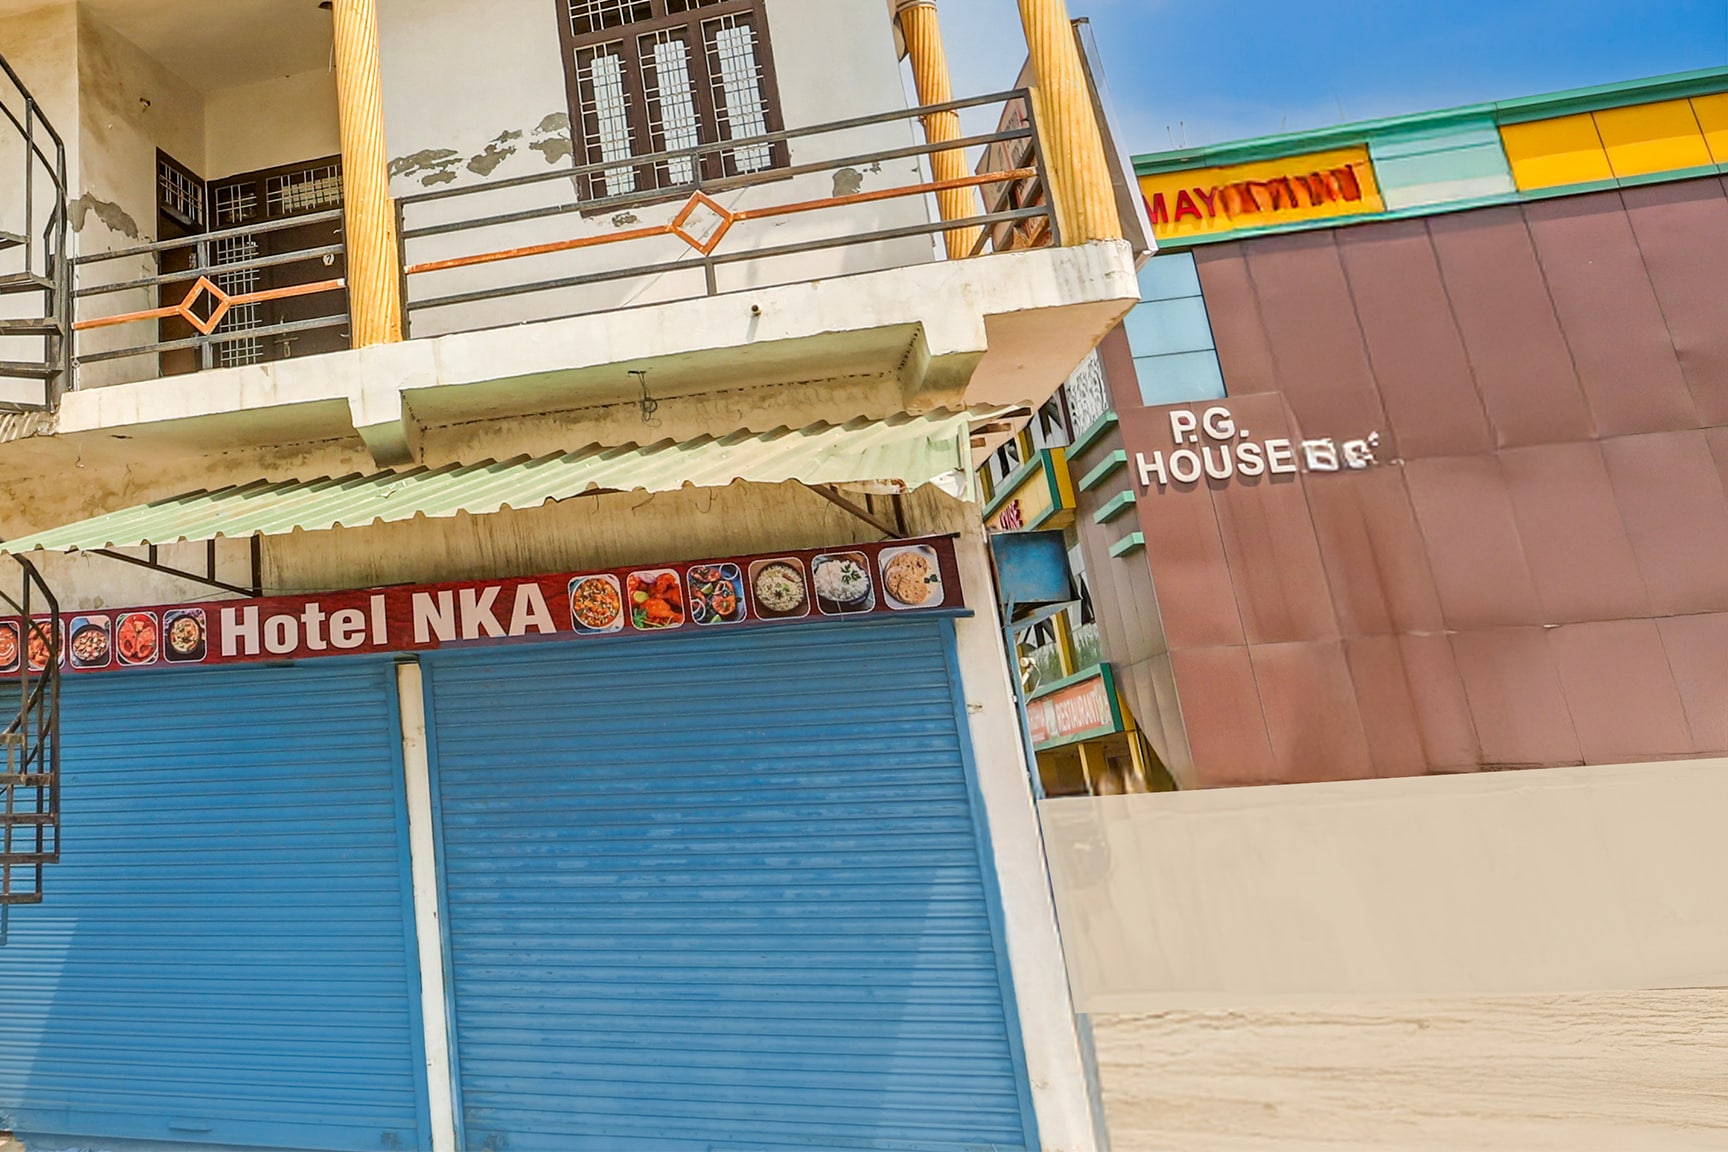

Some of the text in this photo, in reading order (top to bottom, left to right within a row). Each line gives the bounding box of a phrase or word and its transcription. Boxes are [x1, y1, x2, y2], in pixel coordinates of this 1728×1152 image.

[1135, 438, 1297, 487] HOUSE
[221, 583, 557, 657] Hotel NKA
